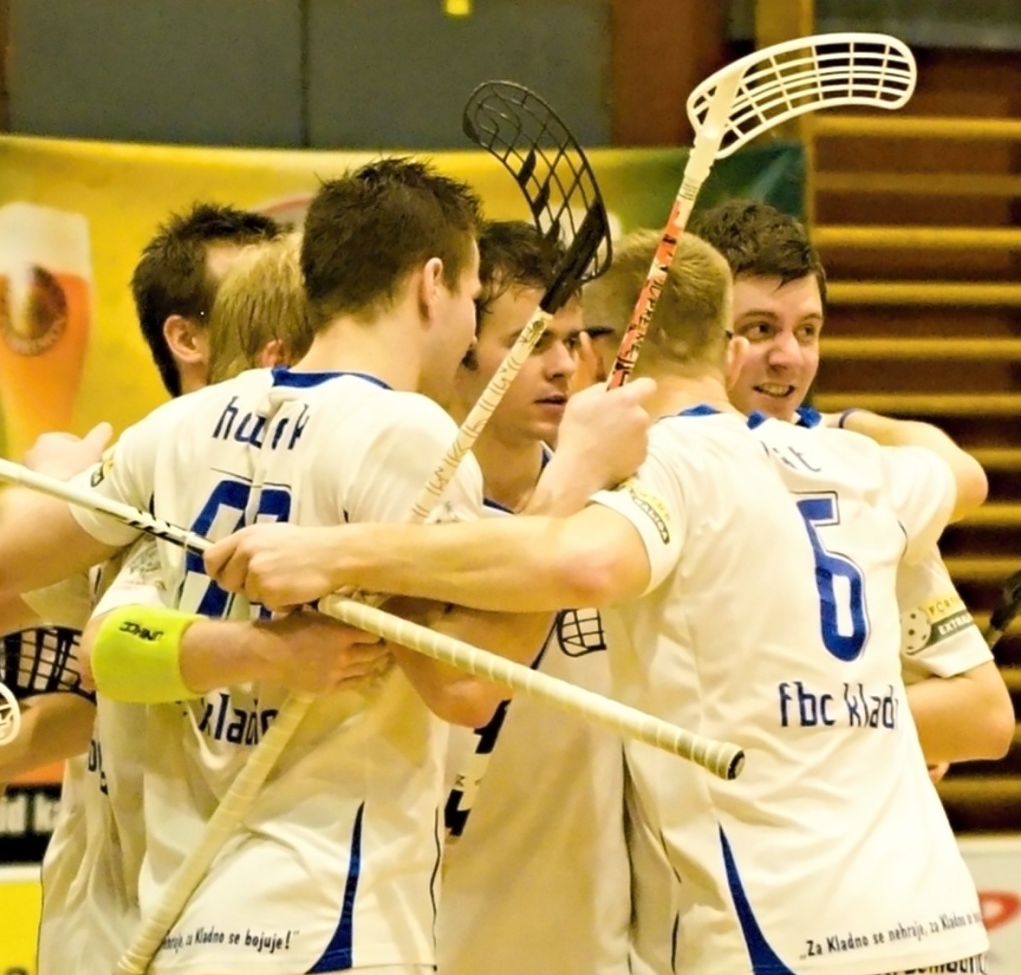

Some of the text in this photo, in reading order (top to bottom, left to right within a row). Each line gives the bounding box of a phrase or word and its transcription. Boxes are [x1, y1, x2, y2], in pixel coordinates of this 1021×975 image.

[790, 492, 870, 662] 6
[779, 682, 835, 727] fbc
[195, 926, 225, 944] Kladno
[228, 932, 240, 945] se
[827, 932, 869, 953] Kladno
[873, 932, 885, 945] se
